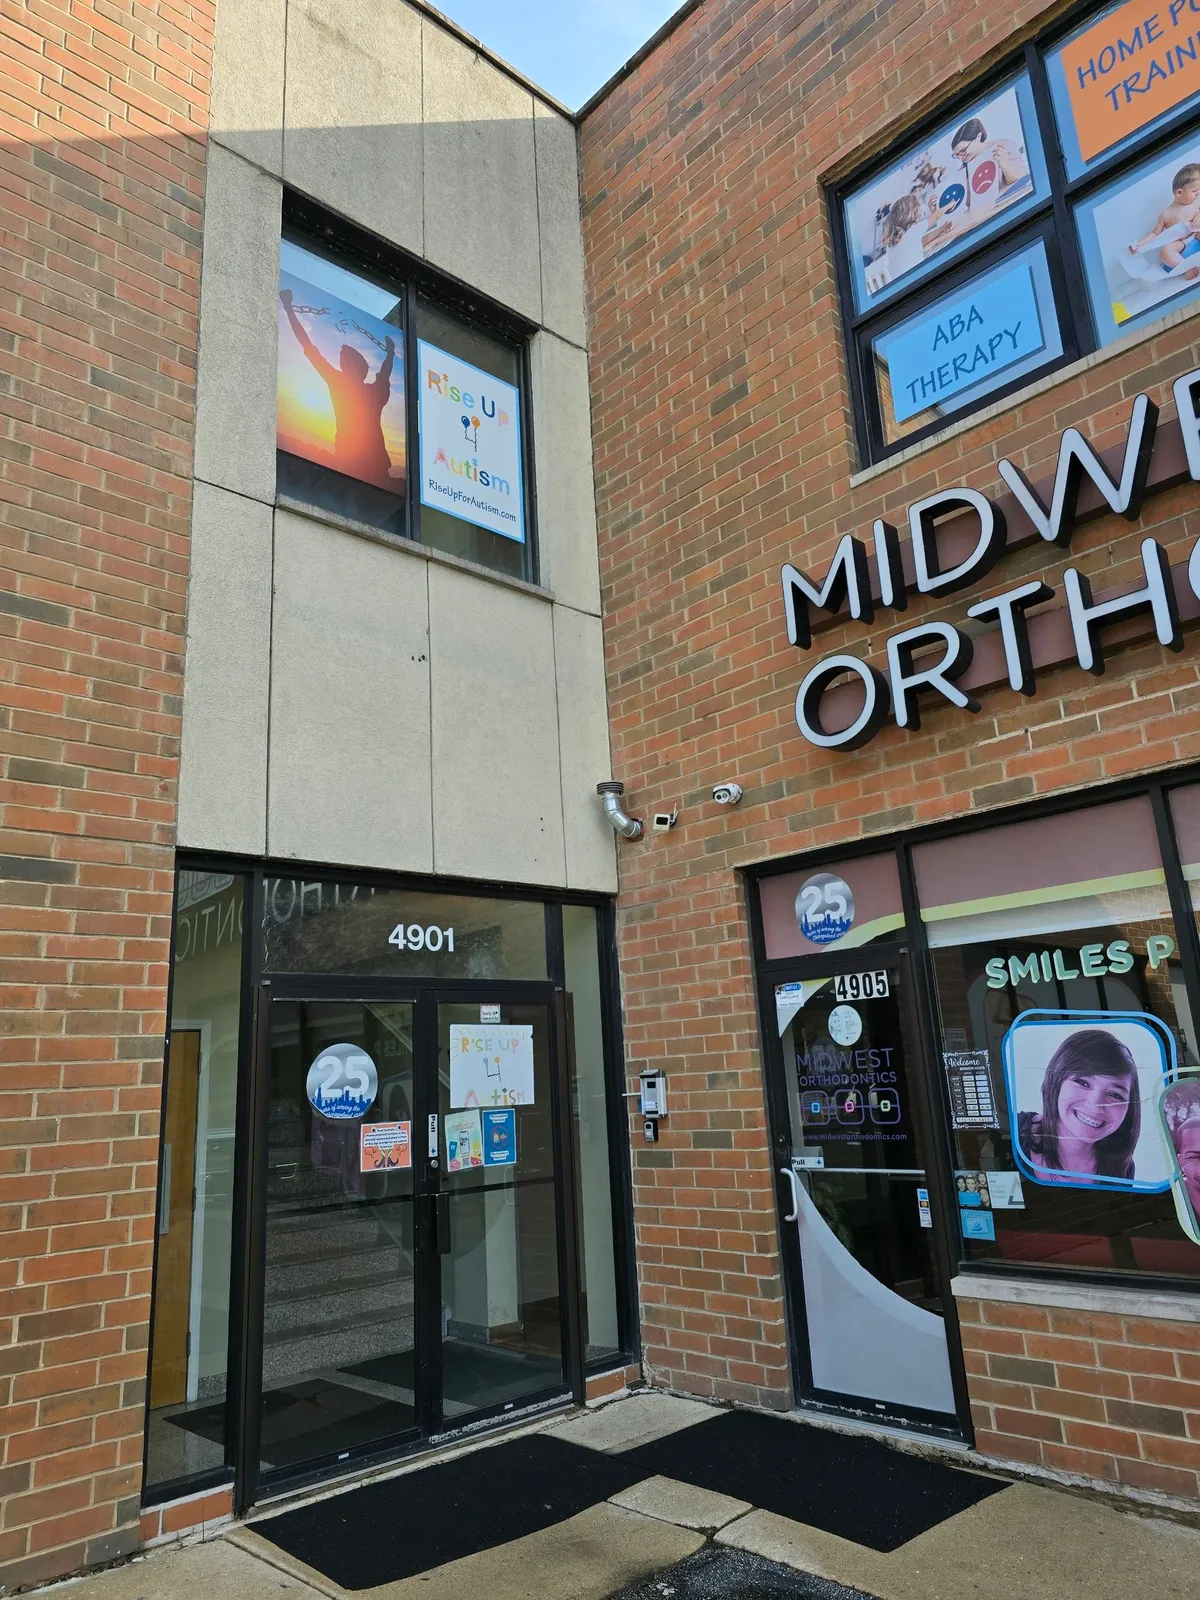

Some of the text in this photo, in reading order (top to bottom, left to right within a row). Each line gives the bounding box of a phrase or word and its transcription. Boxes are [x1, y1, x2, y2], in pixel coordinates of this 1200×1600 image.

[1077, 0, 1200, 89] HOME P
[1104, 31, 1200, 111] TRAIN
[931, 305, 984, 351] ABA
[906, 321, 1022, 404] THERAPY
[427, 369, 509, 427] Rise Up
[433, 446, 510, 495] Autism
[428, 478, 516, 522] RiseUpForAutism.com
[794, 536, 1200, 750] ORTH
[801, 881, 847, 923] 25
[388, 923, 455, 952] 4901
[837, 971, 887, 1000] 4905
[985, 939, 1135, 989] SMILES
[498, 1038, 519, 1054] UP
[796, 1048, 894, 1072] MIDWEST
[948, 1057, 980, 1068] Welcome
[315, 1055, 370, 1098] 25
[799, 1071, 897, 1087] ORTHODONTICS
[803, 1133, 907, 1141] www.midwestorthodontics.com
